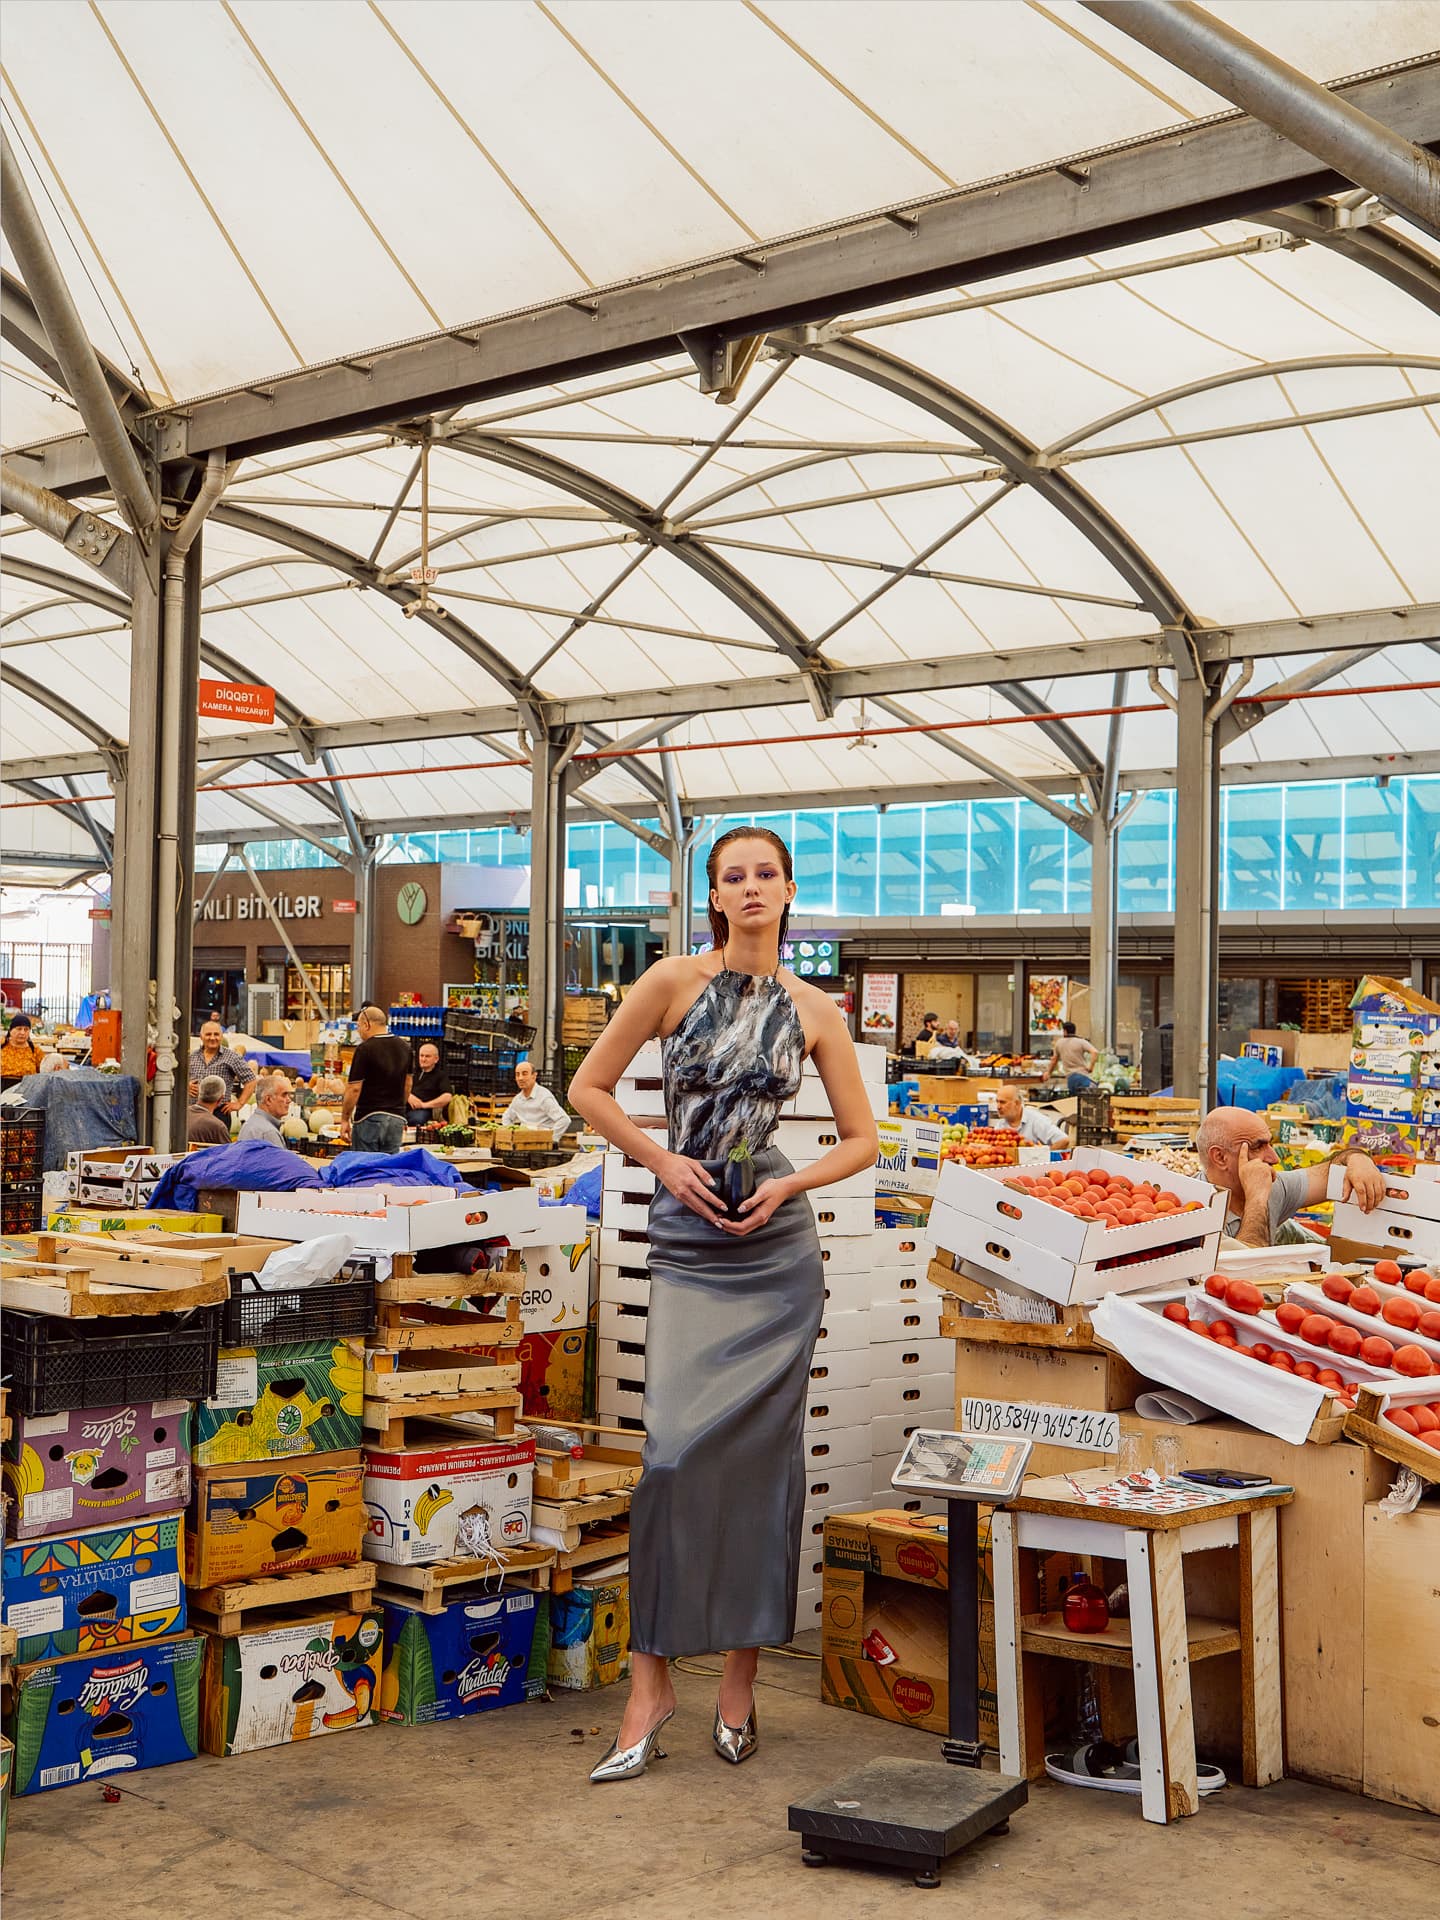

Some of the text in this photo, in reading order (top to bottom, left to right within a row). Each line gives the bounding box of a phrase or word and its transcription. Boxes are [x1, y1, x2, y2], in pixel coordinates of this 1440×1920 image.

[202, 701, 233, 713] KAMERA
[260, 1360, 284, 1368] PRODUCT
[292, 1357, 316, 1365] ECUADOR
[80, 1408, 138, 1447] Selva
[371, 1465, 401, 1476] PREMIUM
[417, 1451, 530, 1475] PREMIUM BANANAS PREMIUM BANANAS
[503, 1519, 523, 1535] Dole
[59, 1563, 135, 1589] ECUALYRA
[456, 1657, 511, 1697] Frutadeli
[77, 1666, 150, 1711] Frutadeli
[896, 1684, 932, 1702] Del Monte
